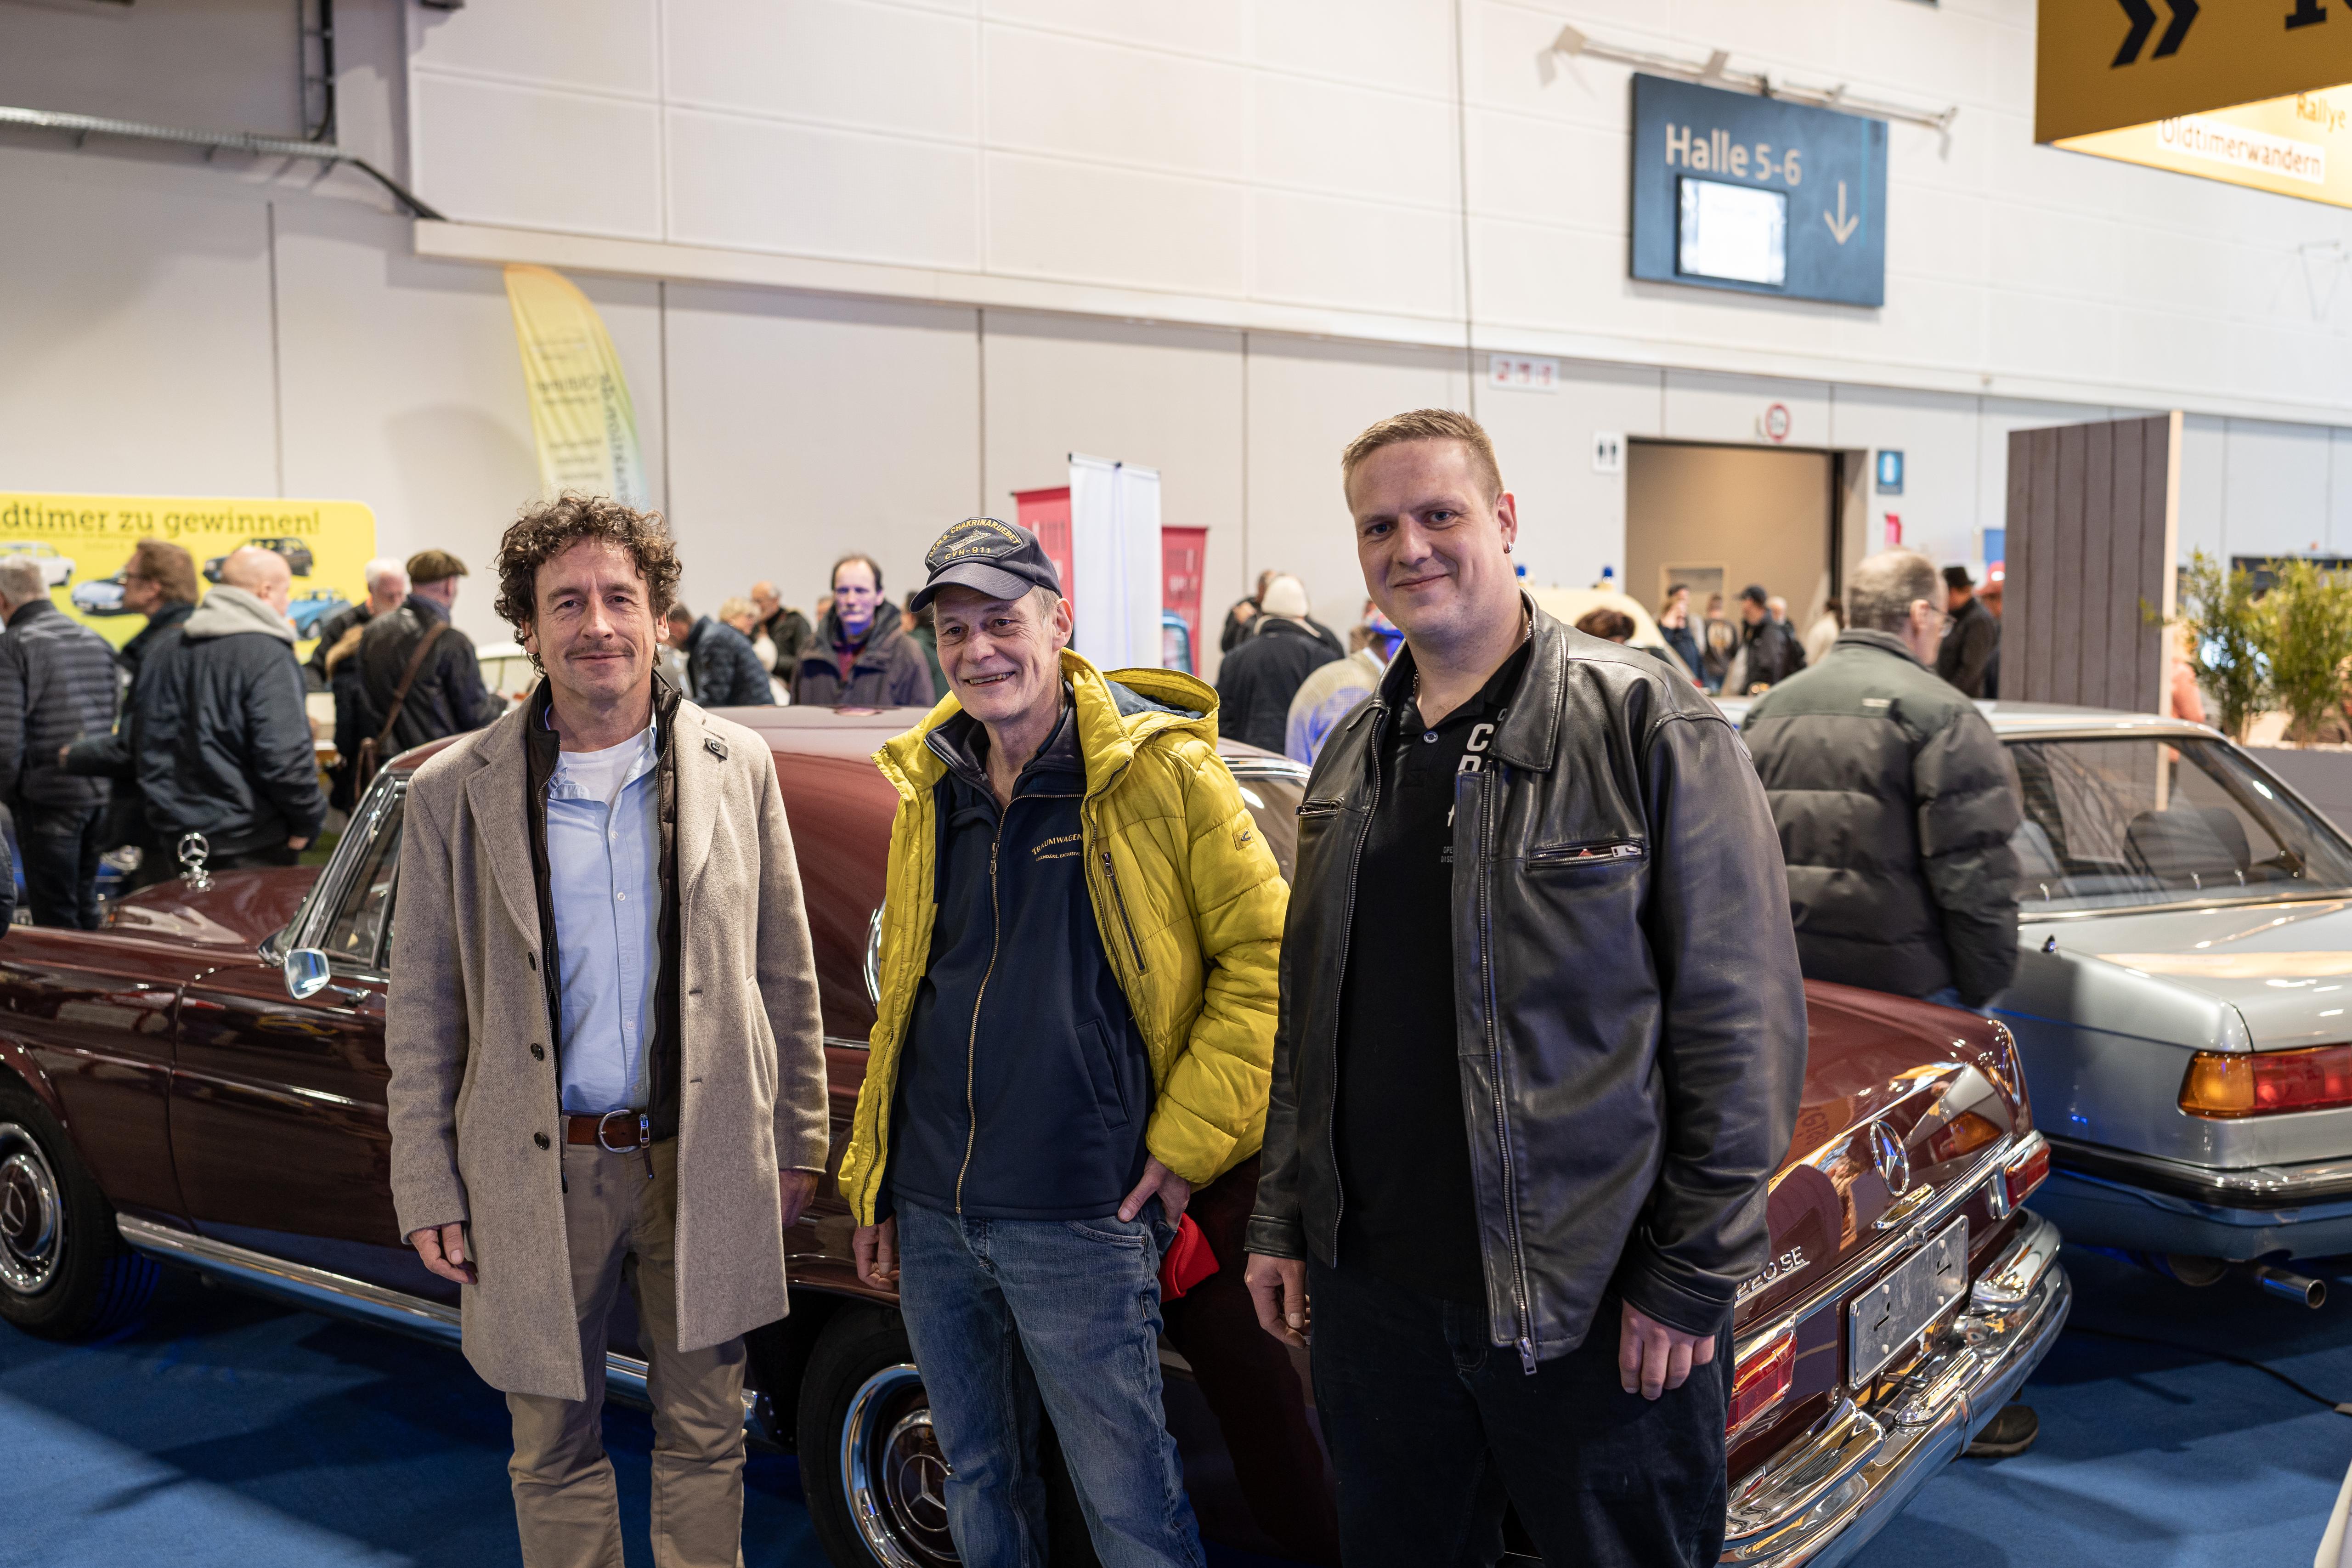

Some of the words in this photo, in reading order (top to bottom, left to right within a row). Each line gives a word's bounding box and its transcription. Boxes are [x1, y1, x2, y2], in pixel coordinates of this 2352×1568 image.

[1665, 123, 1749, 178] Halle
[1754, 144, 1802, 187] 5-6
[2162, 116, 2321, 177] Oldtimerwandern
[119, 511, 154, 532] zu
[164, 506, 320, 538] gewinnen!
[950, 519, 1021, 544] CHAKRINARUEBET
[944, 547, 991, 560] CVH-911
[1036, 853, 1059, 861] LEGENDÄRE,
